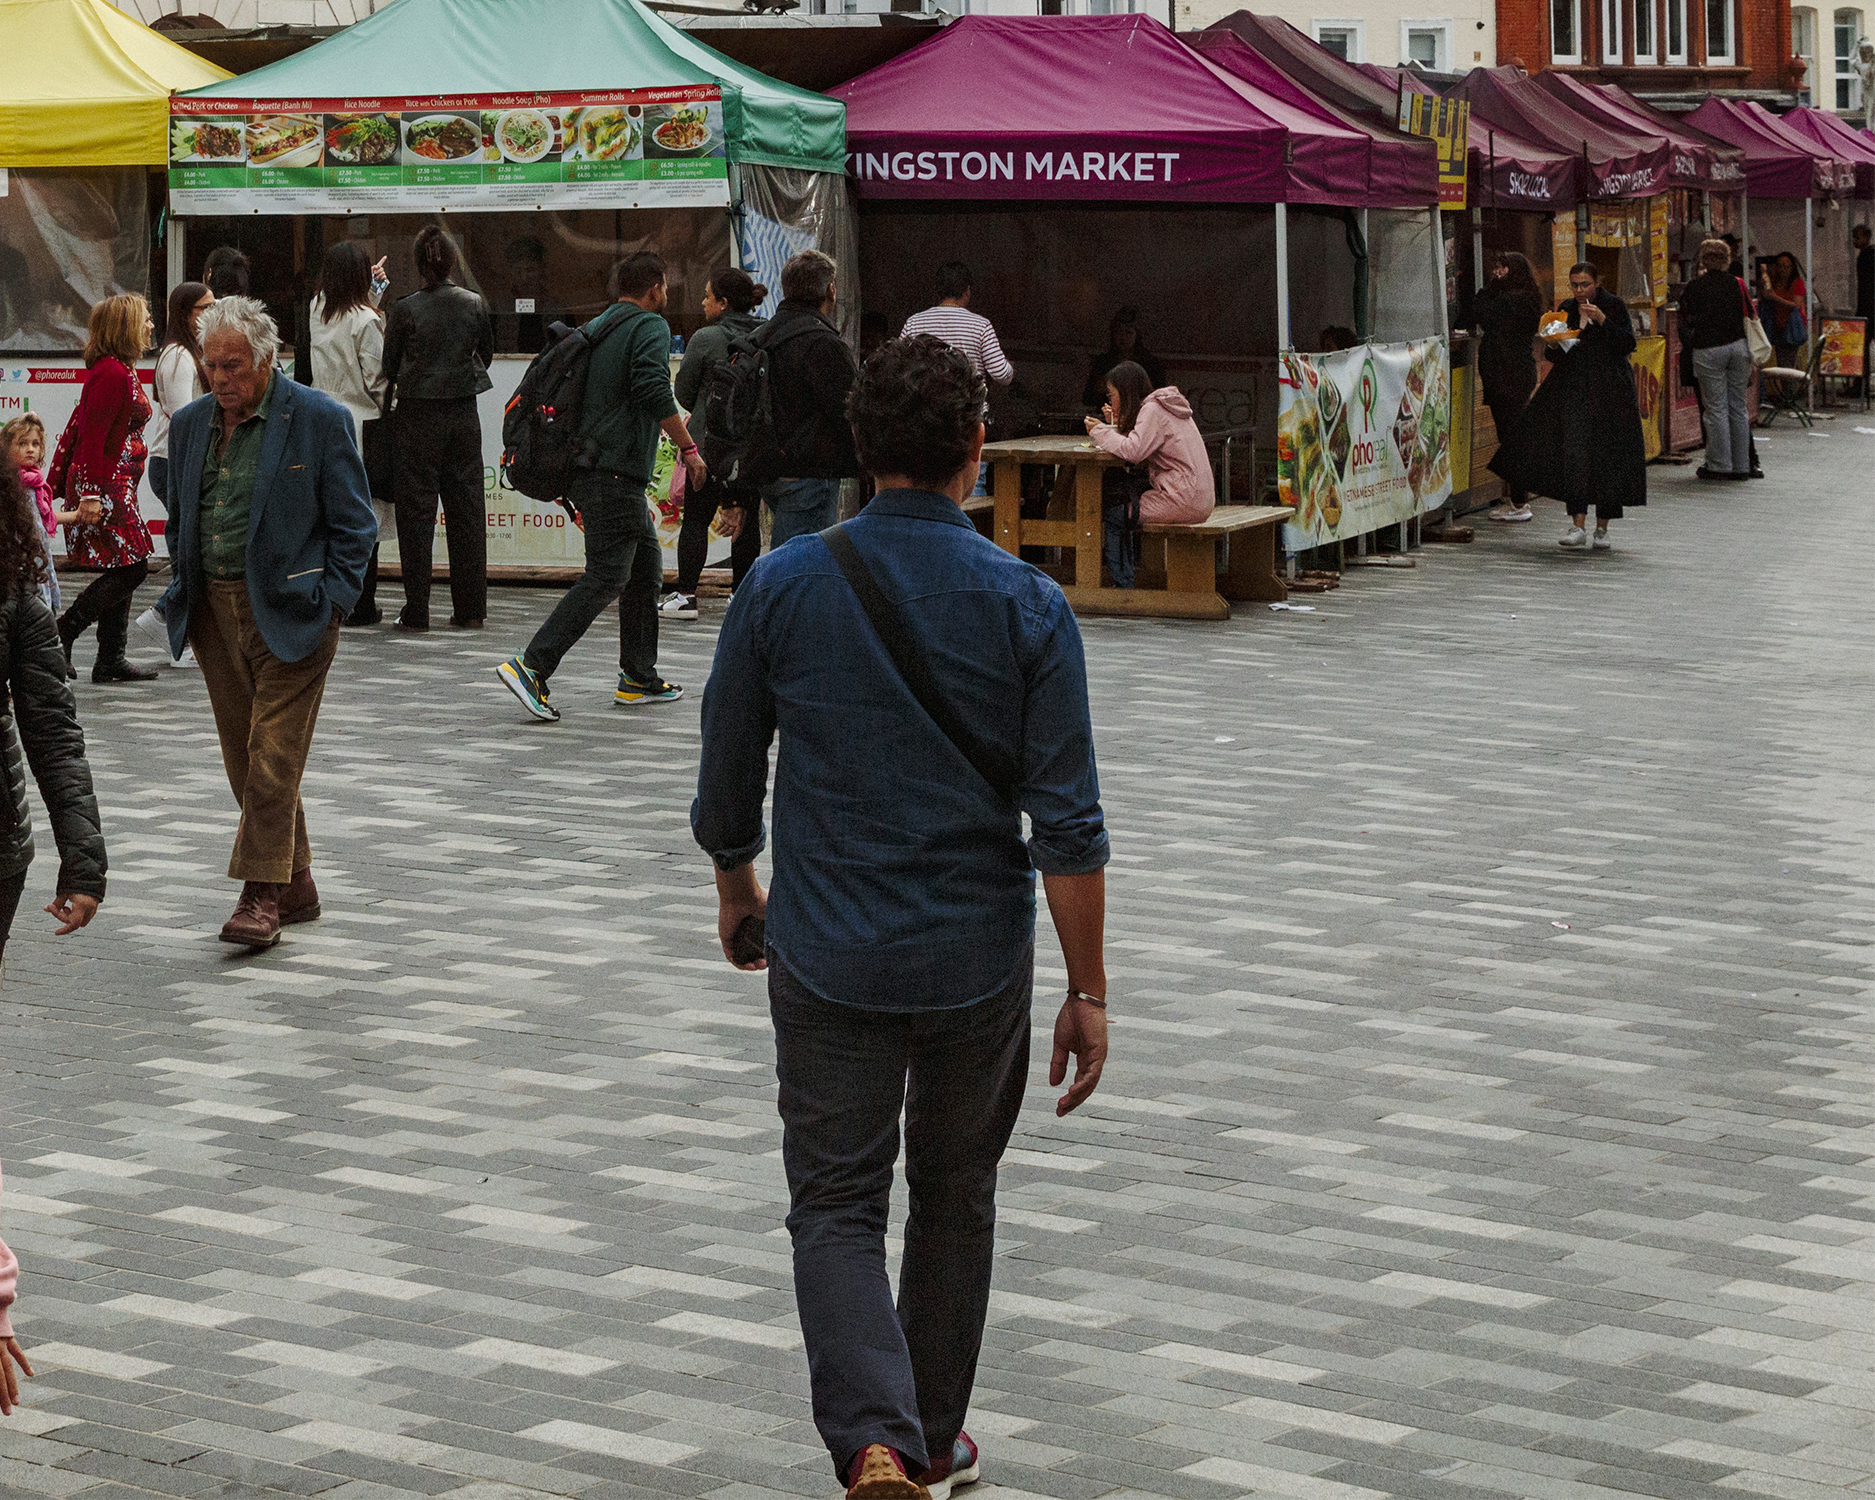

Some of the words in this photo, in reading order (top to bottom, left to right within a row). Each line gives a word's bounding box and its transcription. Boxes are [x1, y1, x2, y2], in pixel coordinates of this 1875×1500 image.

[581, 94, 608, 103] Summer
[609, 92, 625, 101] Rolls
[648, 90, 683, 100] Vegetarian
[683, 89, 705, 99] Spring
[705, 87, 722, 97] Rolls
[192, 102, 206, 110] Pork
[215, 102, 239, 110] Chicken
[252, 101, 281, 111] Baguette
[282, 100, 301, 110] (Banh
[302, 100, 313, 110] Mi)
[344, 100, 358, 109] Rice
[358, 99, 381, 109] Noodle
[405, 99, 419, 108] Rice
[430, 98, 455, 107] Chicken
[463, 97, 478, 106] Pork
[492, 96, 515, 105] Noodle
[516, 96, 532, 106] Soup
[533, 94, 552, 105] (Pho)
[1025, 151, 1180, 182] MARKET
[34, 370, 77, 382] @phorealuk
[0, 397, 20, 409] TM
[523, 514, 565, 528] FOOD
